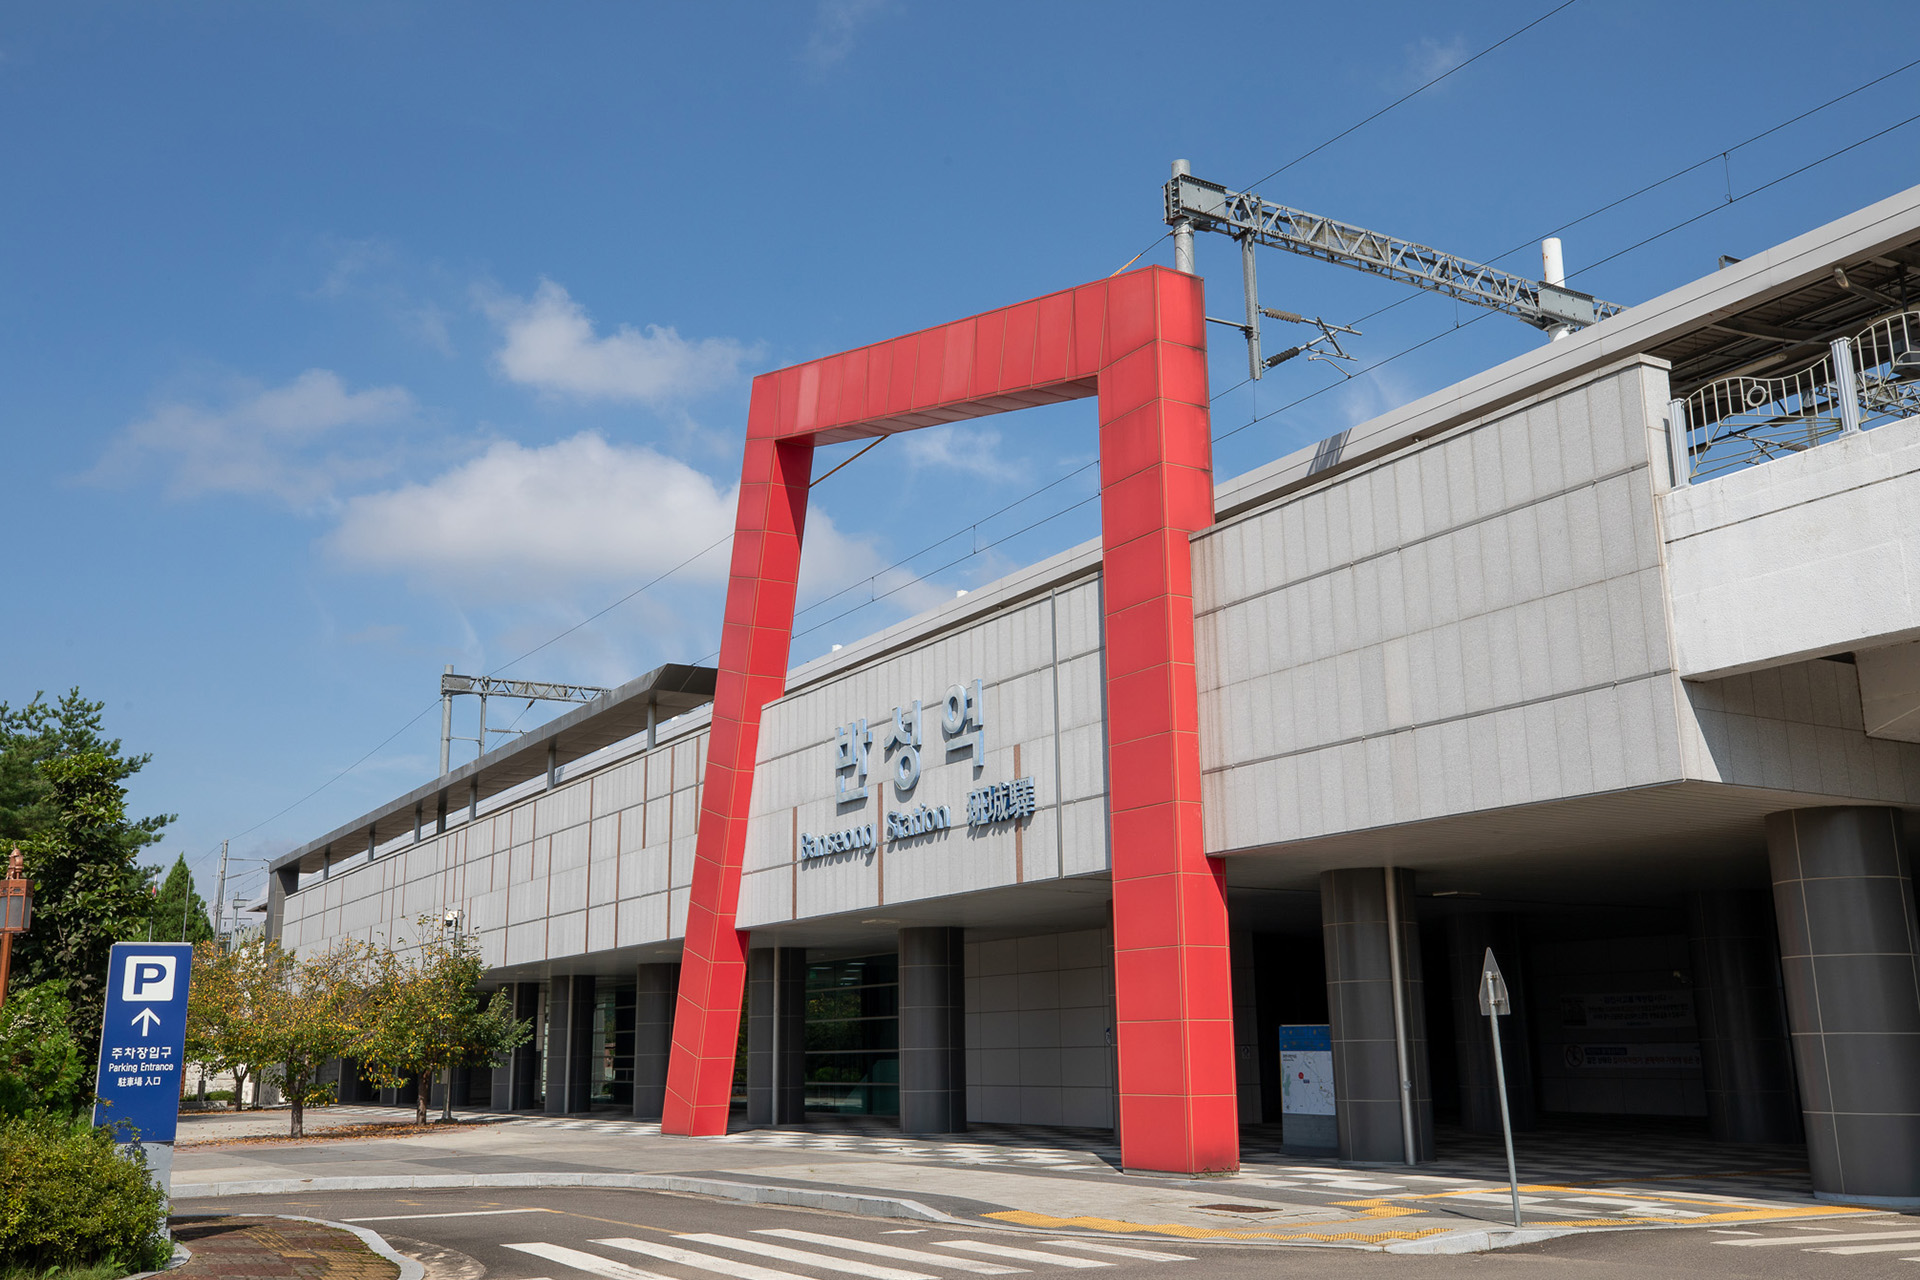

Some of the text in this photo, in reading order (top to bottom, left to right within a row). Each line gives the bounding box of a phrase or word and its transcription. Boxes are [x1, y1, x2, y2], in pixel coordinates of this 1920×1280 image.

[835, 678, 984, 804] 반성역
[801, 803, 951, 860] Banseong Station
[133, 963, 167, 995] P
[108, 1062, 174, 1073] Parking Entrance
[111, 1046, 172, 1060] 주차장입구
